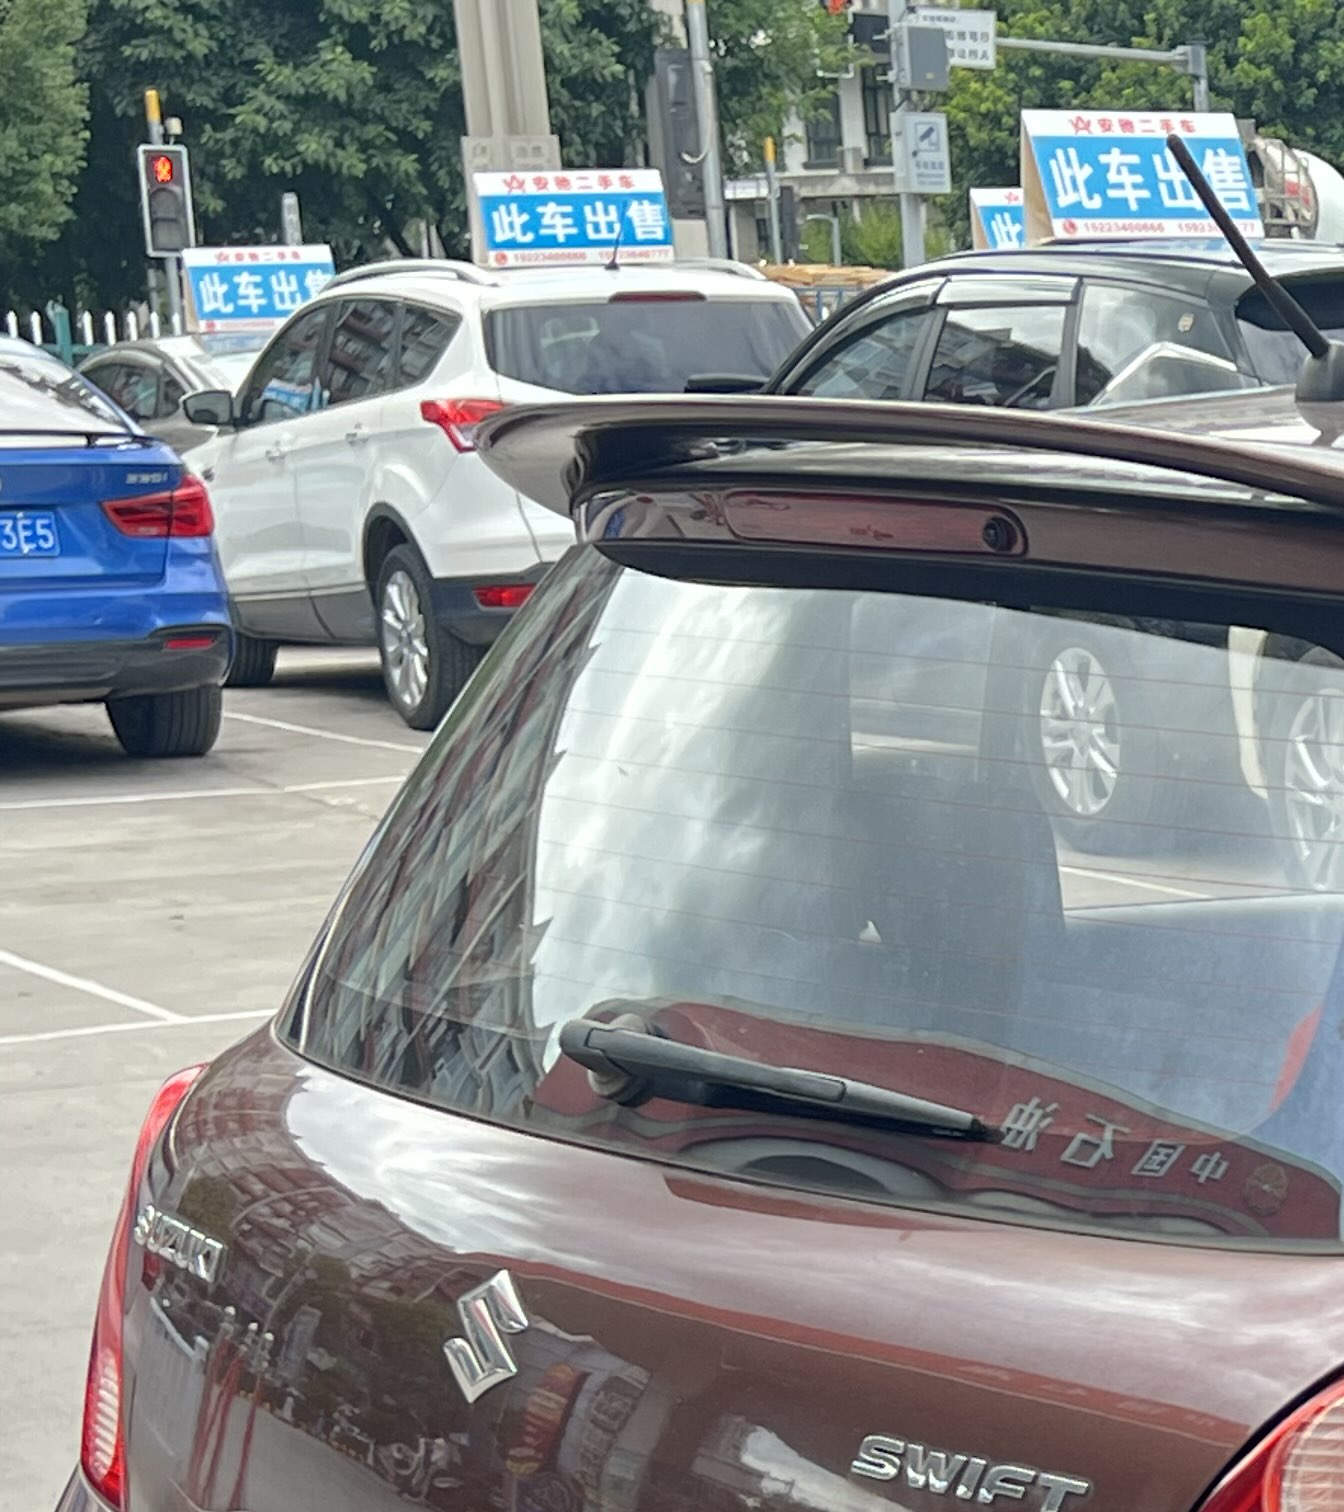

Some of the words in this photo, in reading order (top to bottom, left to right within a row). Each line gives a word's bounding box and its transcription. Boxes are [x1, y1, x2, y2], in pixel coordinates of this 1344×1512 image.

[1049, 147, 1251, 211] 此车出售
[491, 200, 666, 243] 此车出售
